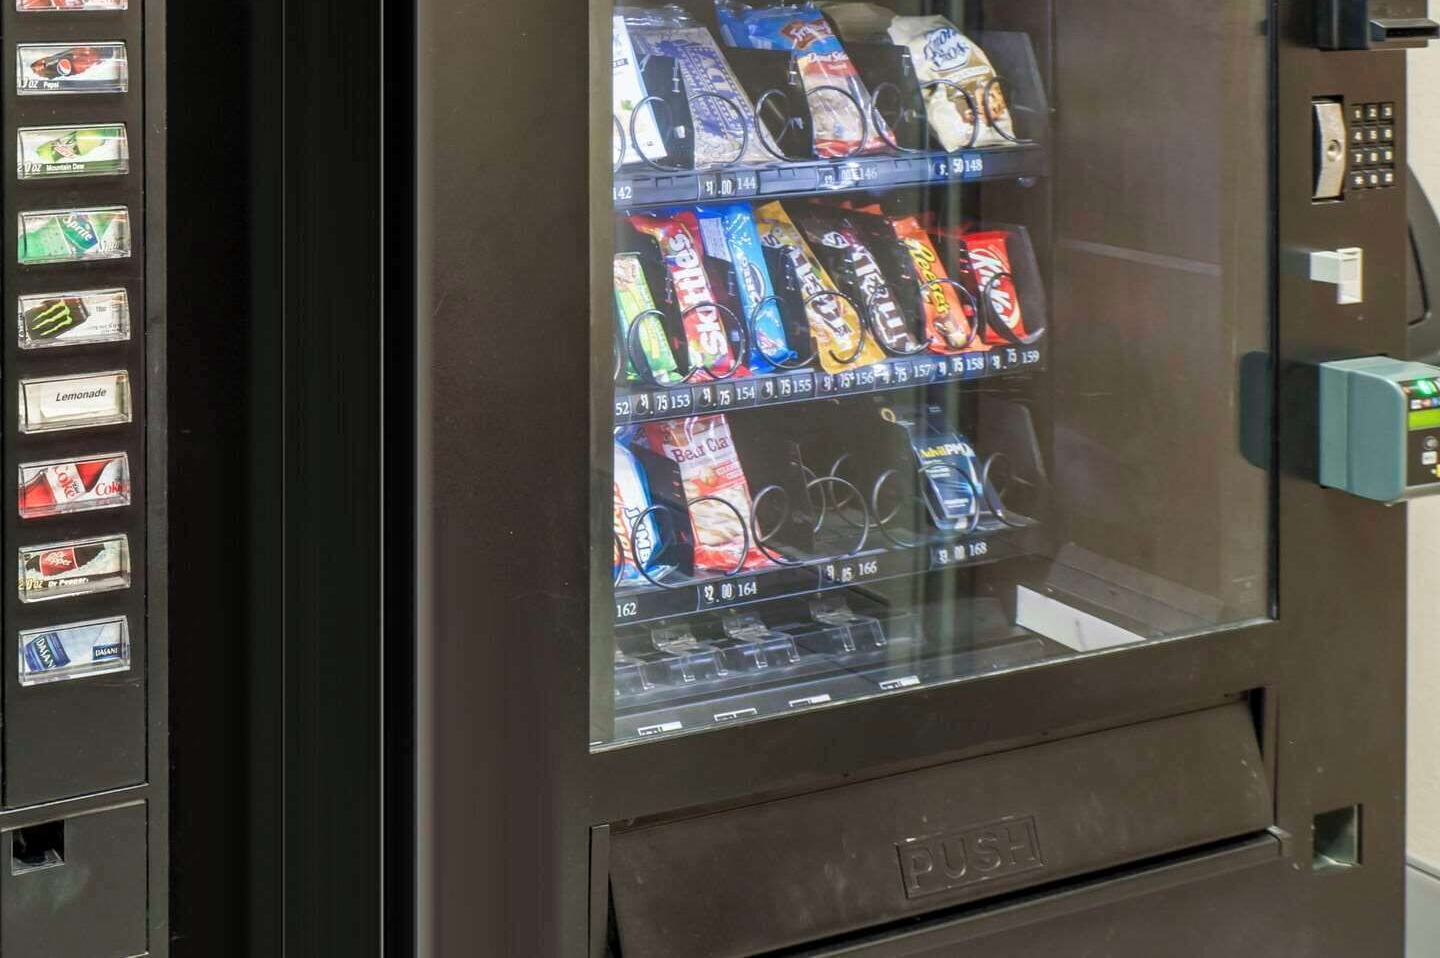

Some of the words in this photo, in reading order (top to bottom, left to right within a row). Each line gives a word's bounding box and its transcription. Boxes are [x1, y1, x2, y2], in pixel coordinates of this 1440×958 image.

[1369, 109, 1376, 117] 2
[46, 163, 72, 172] Mountain
[965, 159, 983, 172] 148
[860, 168, 878, 180] 146
[737, 178, 756, 190] 144
[612, 186, 632, 200] 142
[62, 214, 93, 240] Sprite
[1022, 350, 1040, 364] 159
[913, 364, 930, 378] 157
[966, 358, 984, 371] 158
[855, 372, 873, 386] 156
[736, 387, 754, 400] 154
[793, 380, 811, 393] 155
[55, 388, 107, 403] Lemonade
[671, 395, 691, 409] 153
[969, 542, 987, 556] 168
[859, 561, 877, 575] 166
[704, 584, 732, 603] $2.00
[738, 582, 757, 597] 164
[617, 602, 637, 618] 162
[95, 647, 118, 657] DASANI
[911, 821, 1036, 890] PUSH
